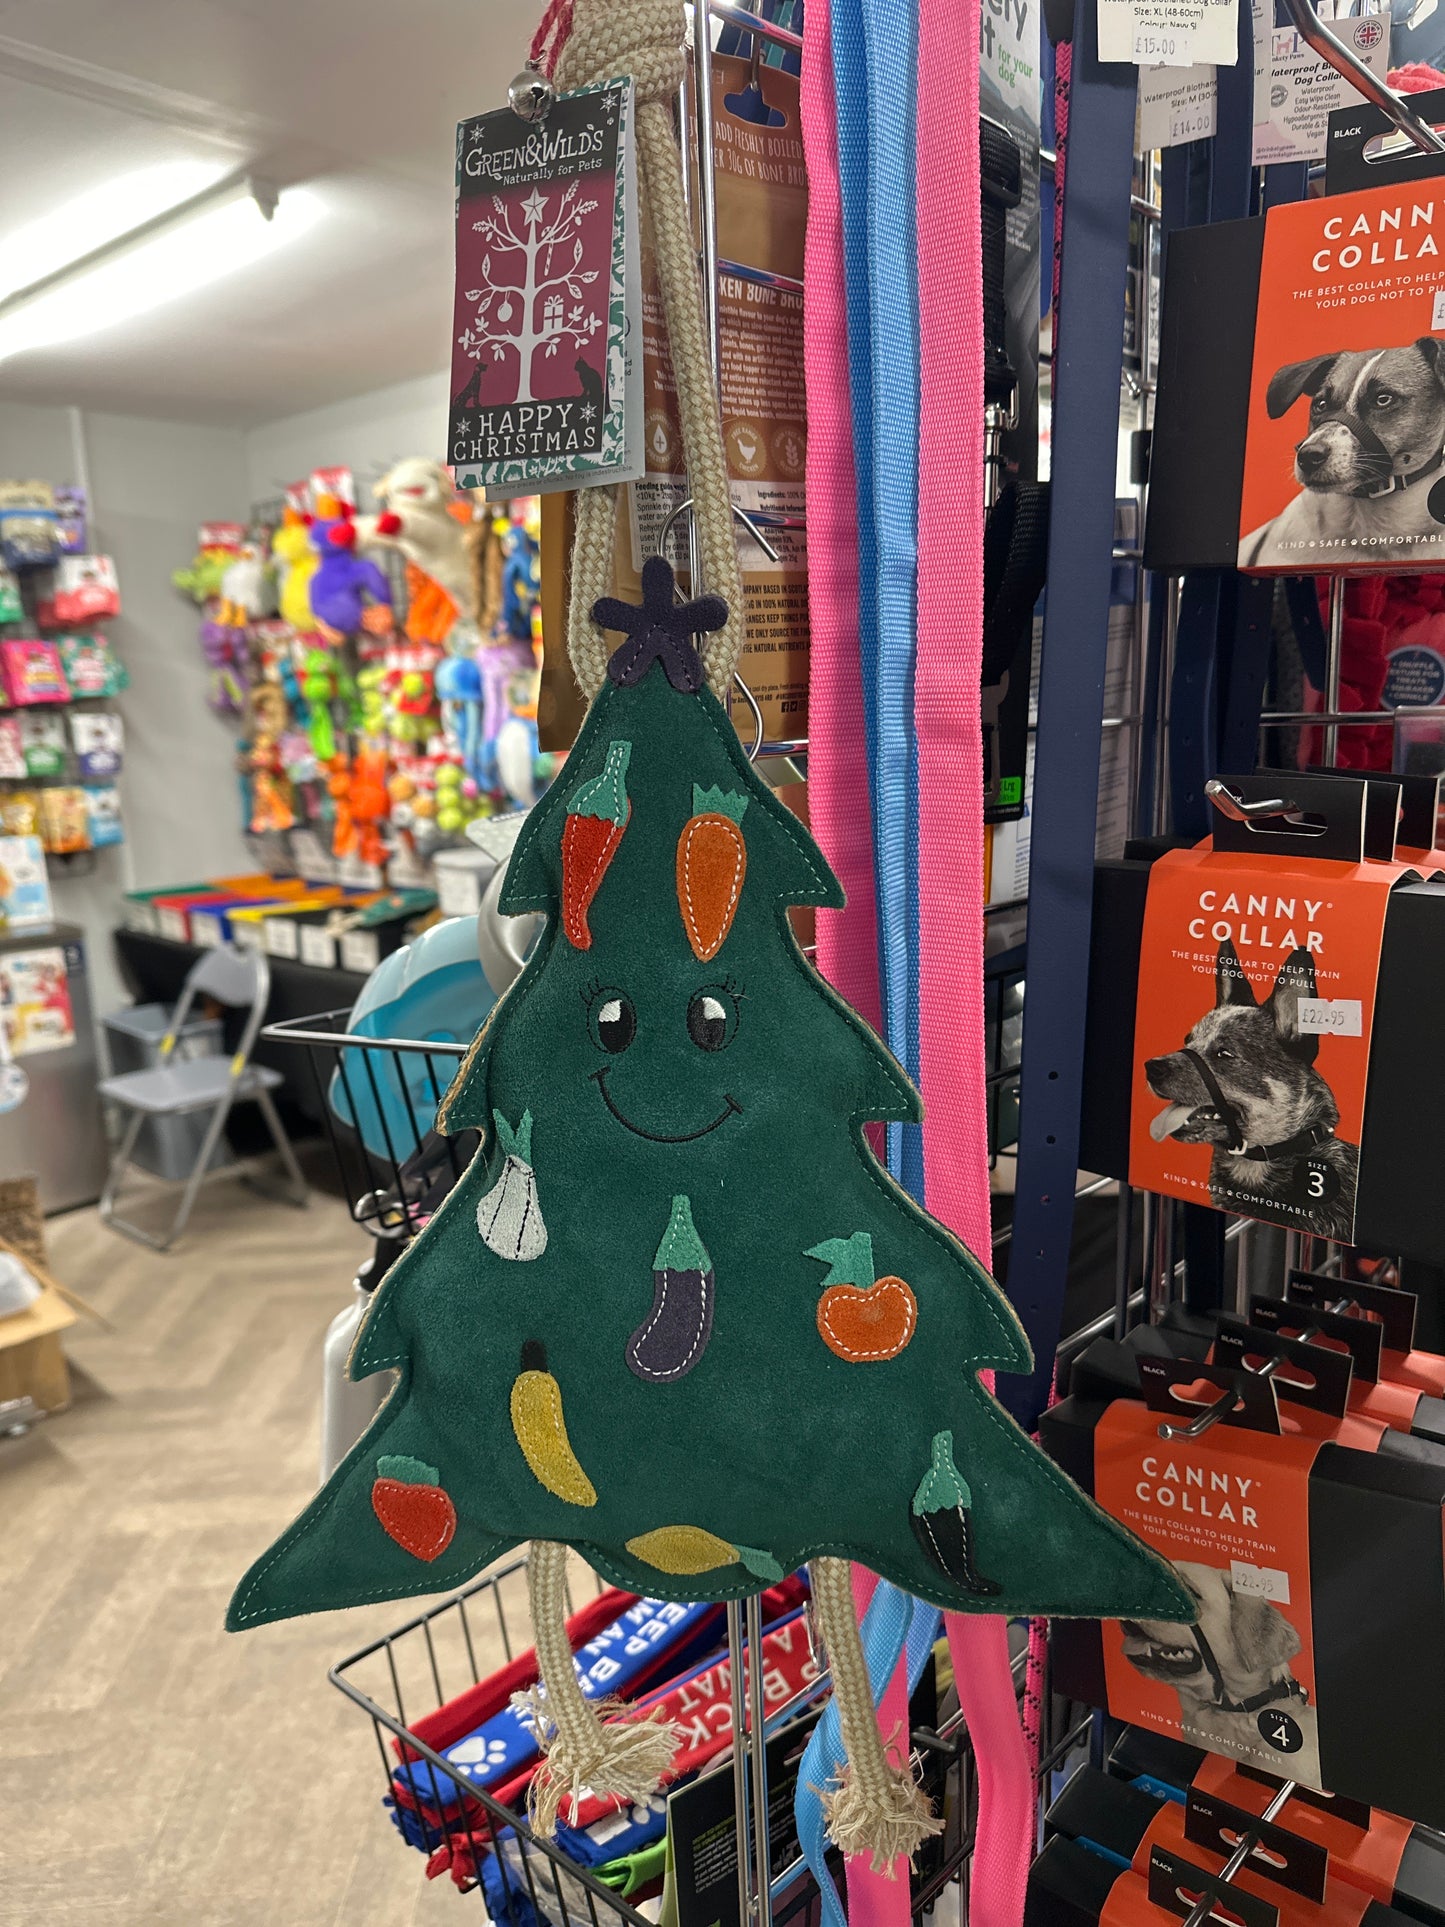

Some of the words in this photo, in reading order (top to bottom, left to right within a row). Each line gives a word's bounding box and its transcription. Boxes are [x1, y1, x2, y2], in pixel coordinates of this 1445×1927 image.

[1154, 8, 1163, 16] XL
[1165, 8, 1204, 19] (48-60cm)
[1135, 37, 1175, 55] £15.00
[998, 44, 1011, 64] for
[1014, 56, 1033, 78] your
[1272, 63, 1321, 77] aterproof
[998, 64, 1015, 88] dog
[1294, 76, 1313, 85] Dog
[1144, 87, 1185, 103] Waterproof
[1301, 84, 1335, 95] Waterproof
[1324, 92, 1341, 101] Clean
[716, 121, 733, 143] ADD
[1172, 116, 1210, 138] £14.00
[1334, 126, 1362, 138] BLACK
[503, 167, 554, 186] Naturally
[558, 165, 574, 175] for
[578, 157, 603, 173] Pets
[744, 158, 756, 177] OF
[758, 162, 784, 183] BONE
[1324, 202, 1445, 240] CANN
[1312, 234, 1439, 272] COLLA
[1293, 291, 1313, 299] THE
[1317, 285, 1344, 297] BEST
[1347, 279, 1392, 292] COLLAR
[1396, 276, 1411, 285] TO
[1416, 271, 1445, 282] HELP
[1316, 298, 1346, 309] YOUR
[1350, 294, 1376, 305] DOG
[1380, 290, 1404, 300] NOT
[1409, 288, 1424, 297] TO
[478, 404, 573, 436] HAPPY
[453, 426, 596, 461] CHRISTMAS
[637, 503, 661, 512] Sprinkle
[1277, 542, 1305, 550] KIND
[1319, 539, 1347, 548] SAFE
[1361, 534, 1444, 546] COMFORTABL
[763, 585, 780, 594] BASED
[767, 615, 779, 624] KEEP
[746, 629, 755, 639] WE
[755, 629, 769, 638] ONLY
[770, 628, 790, 638] SOURCE
[754, 643, 777, 653] NATURAL
[1199, 890, 1323, 922] CANNY
[1188, 919, 1325, 954] COLLAR
[1171, 950, 1189, 960] THE
[1193, 953, 1217, 963] BEST
[1219, 956, 1258, 969] COLLAR
[1261, 962, 1275, 971] TO
[1279, 965, 1305, 975] HELP
[1308, 968, 1340, 980] TRAIN
[1191, 965, 1218, 976] YOUR
[1222, 969, 1244, 979] DOG
[1247, 973, 1269, 983] NOT
[1272, 976, 1286, 985] TO
[1290, 978, 1315, 989] PULL
[1302, 1008, 1345, 1025] £22.95
[1307, 1161, 1328, 1171] SIZE
[1307, 1171, 1325, 1198] 3
[1163, 1172, 1188, 1185] KIND
[1199, 1182, 1224, 1195] SAFE
[1235, 1191, 1314, 1219] COMFORTABLE
[1292, 1281, 1314, 1293] BLACK
[1255, 1307, 1278, 1319] BLACK
[1220, 1334, 1244, 1347] BLACK
[1142, 1364, 1166, 1376] BLACK
[1142, 1457, 1252, 1498] CANNY
[1135, 1482, 1259, 1529] COLLAR
[1123, 1508, 1140, 1520] THE
[1142, 1513, 1164, 1525] BEST
[1166, 1519, 1202, 1535] COLLAR
[1205, 1529, 1217, 1539] TO
[1220, 1533, 1244, 1545] HELP
[1246, 1539, 1276, 1553] TRAIN
[1142, 1524, 1168, 1537] YOUR
[1171, 1531, 1190, 1543] DOG
[1193, 1537, 1213, 1547] NOT
[1216, 1542, 1228, 1553] TO
[1232, 1547, 1255, 1559] PULL
[584, 1622, 625, 1657] AN
[1270, 1713, 1289, 1724] SIZE
[1140, 1710, 1164, 1722] KIND
[1175, 1721, 1198, 1734] SAFE
[1208, 1733, 1283, 1764] COMFORTABLE
[1272, 1725, 1290, 1747] 4
[1192, 1804, 1213, 1817] BLACK
[1151, 1857, 1173, 1874] BLACK
